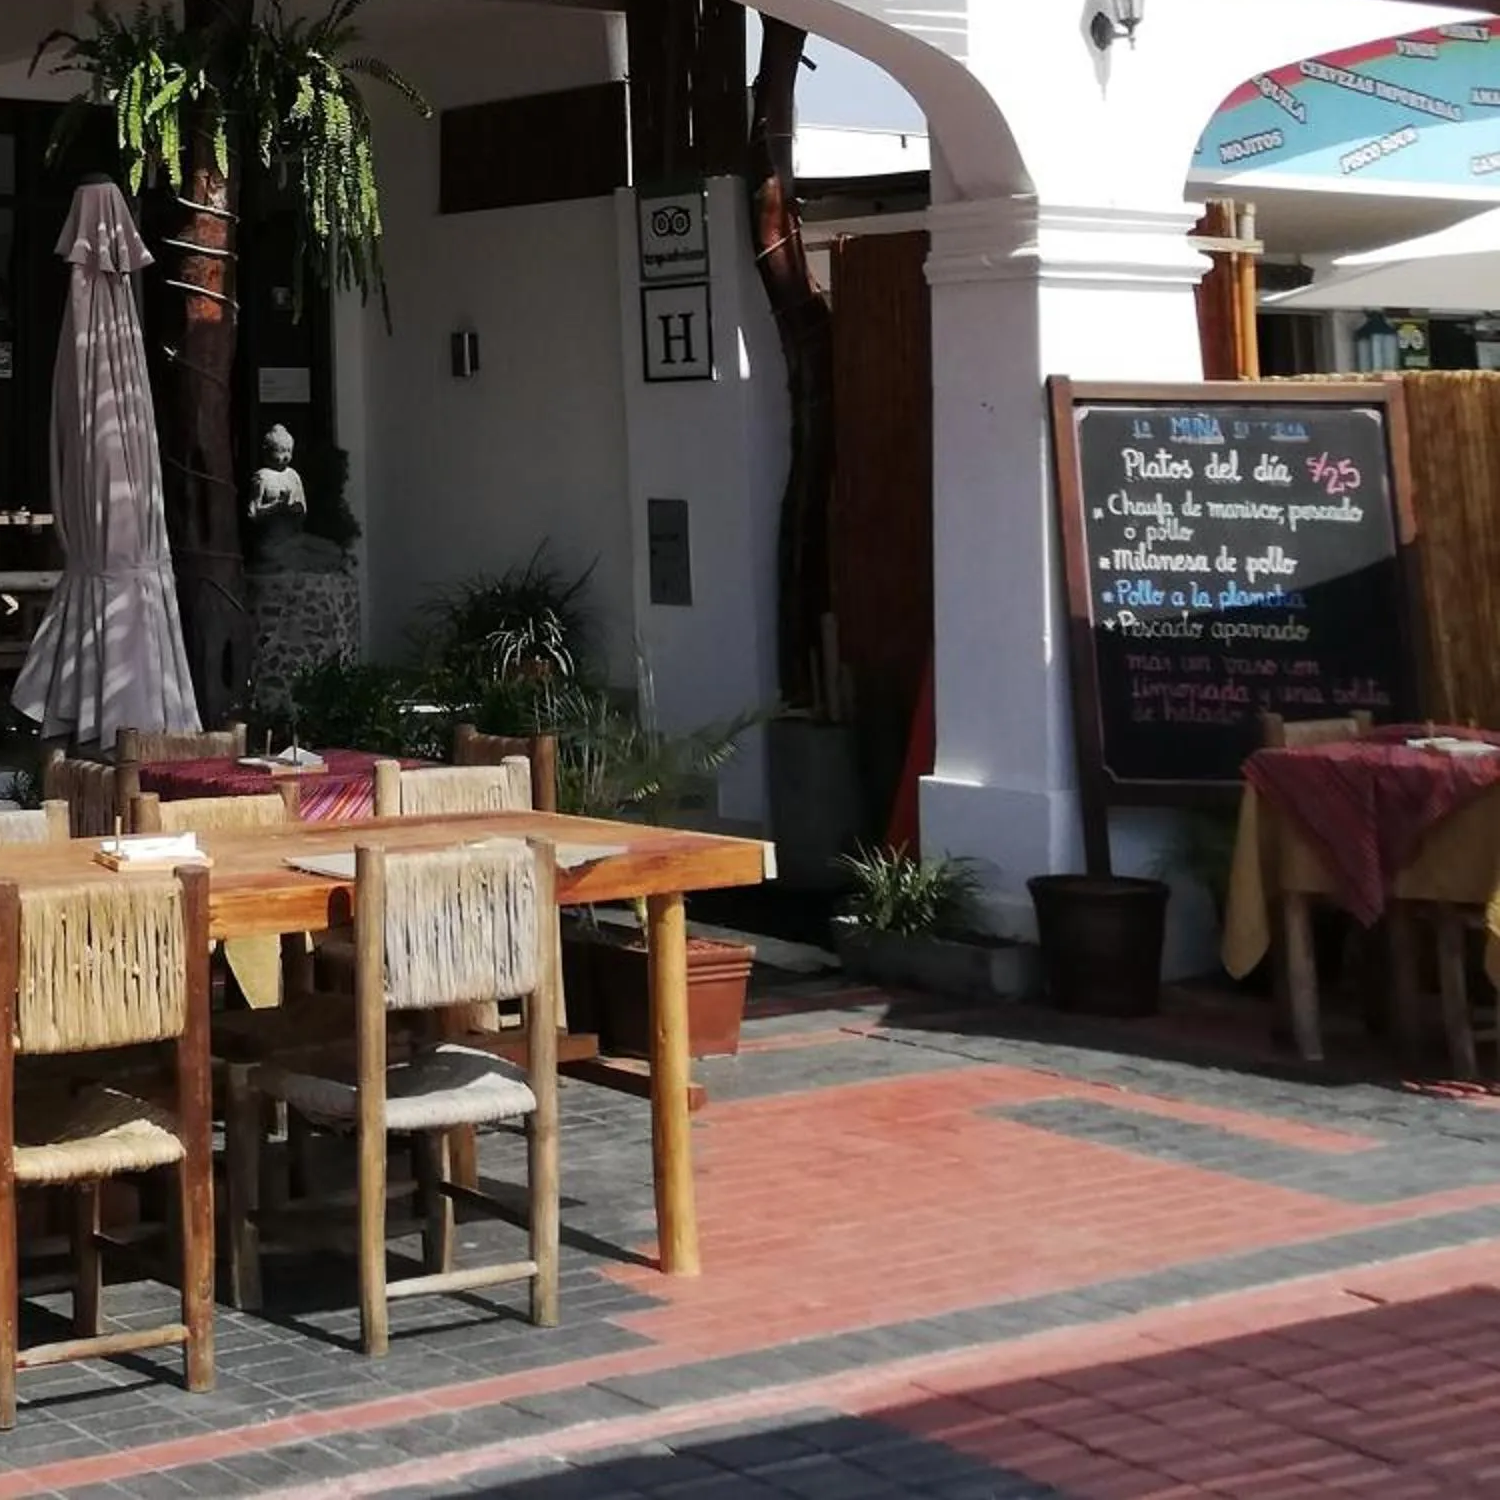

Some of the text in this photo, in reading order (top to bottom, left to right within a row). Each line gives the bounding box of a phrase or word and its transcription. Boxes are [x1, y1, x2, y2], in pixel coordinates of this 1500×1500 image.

[1299, 59, 1376, 96] CERVEZAS
[1219, 128, 1284, 164] MOJITOS
[1340, 142, 1381, 174] PISCO
[658, 311, 697, 364] H
[1122, 448, 1194, 480] Platos
[1204, 449, 1243, 481] del
[1107, 489, 1174, 525] Chaufa
[1181, 489, 1202, 517] de
[1287, 496, 1364, 531] pescado
[1124, 518, 1195, 550] o pollo
[1111, 541, 1298, 584] Milanesa de pollo
[1114, 579, 1308, 611] Pollo a la plancha
[1117, 610, 1311, 647] Pescado apanado
